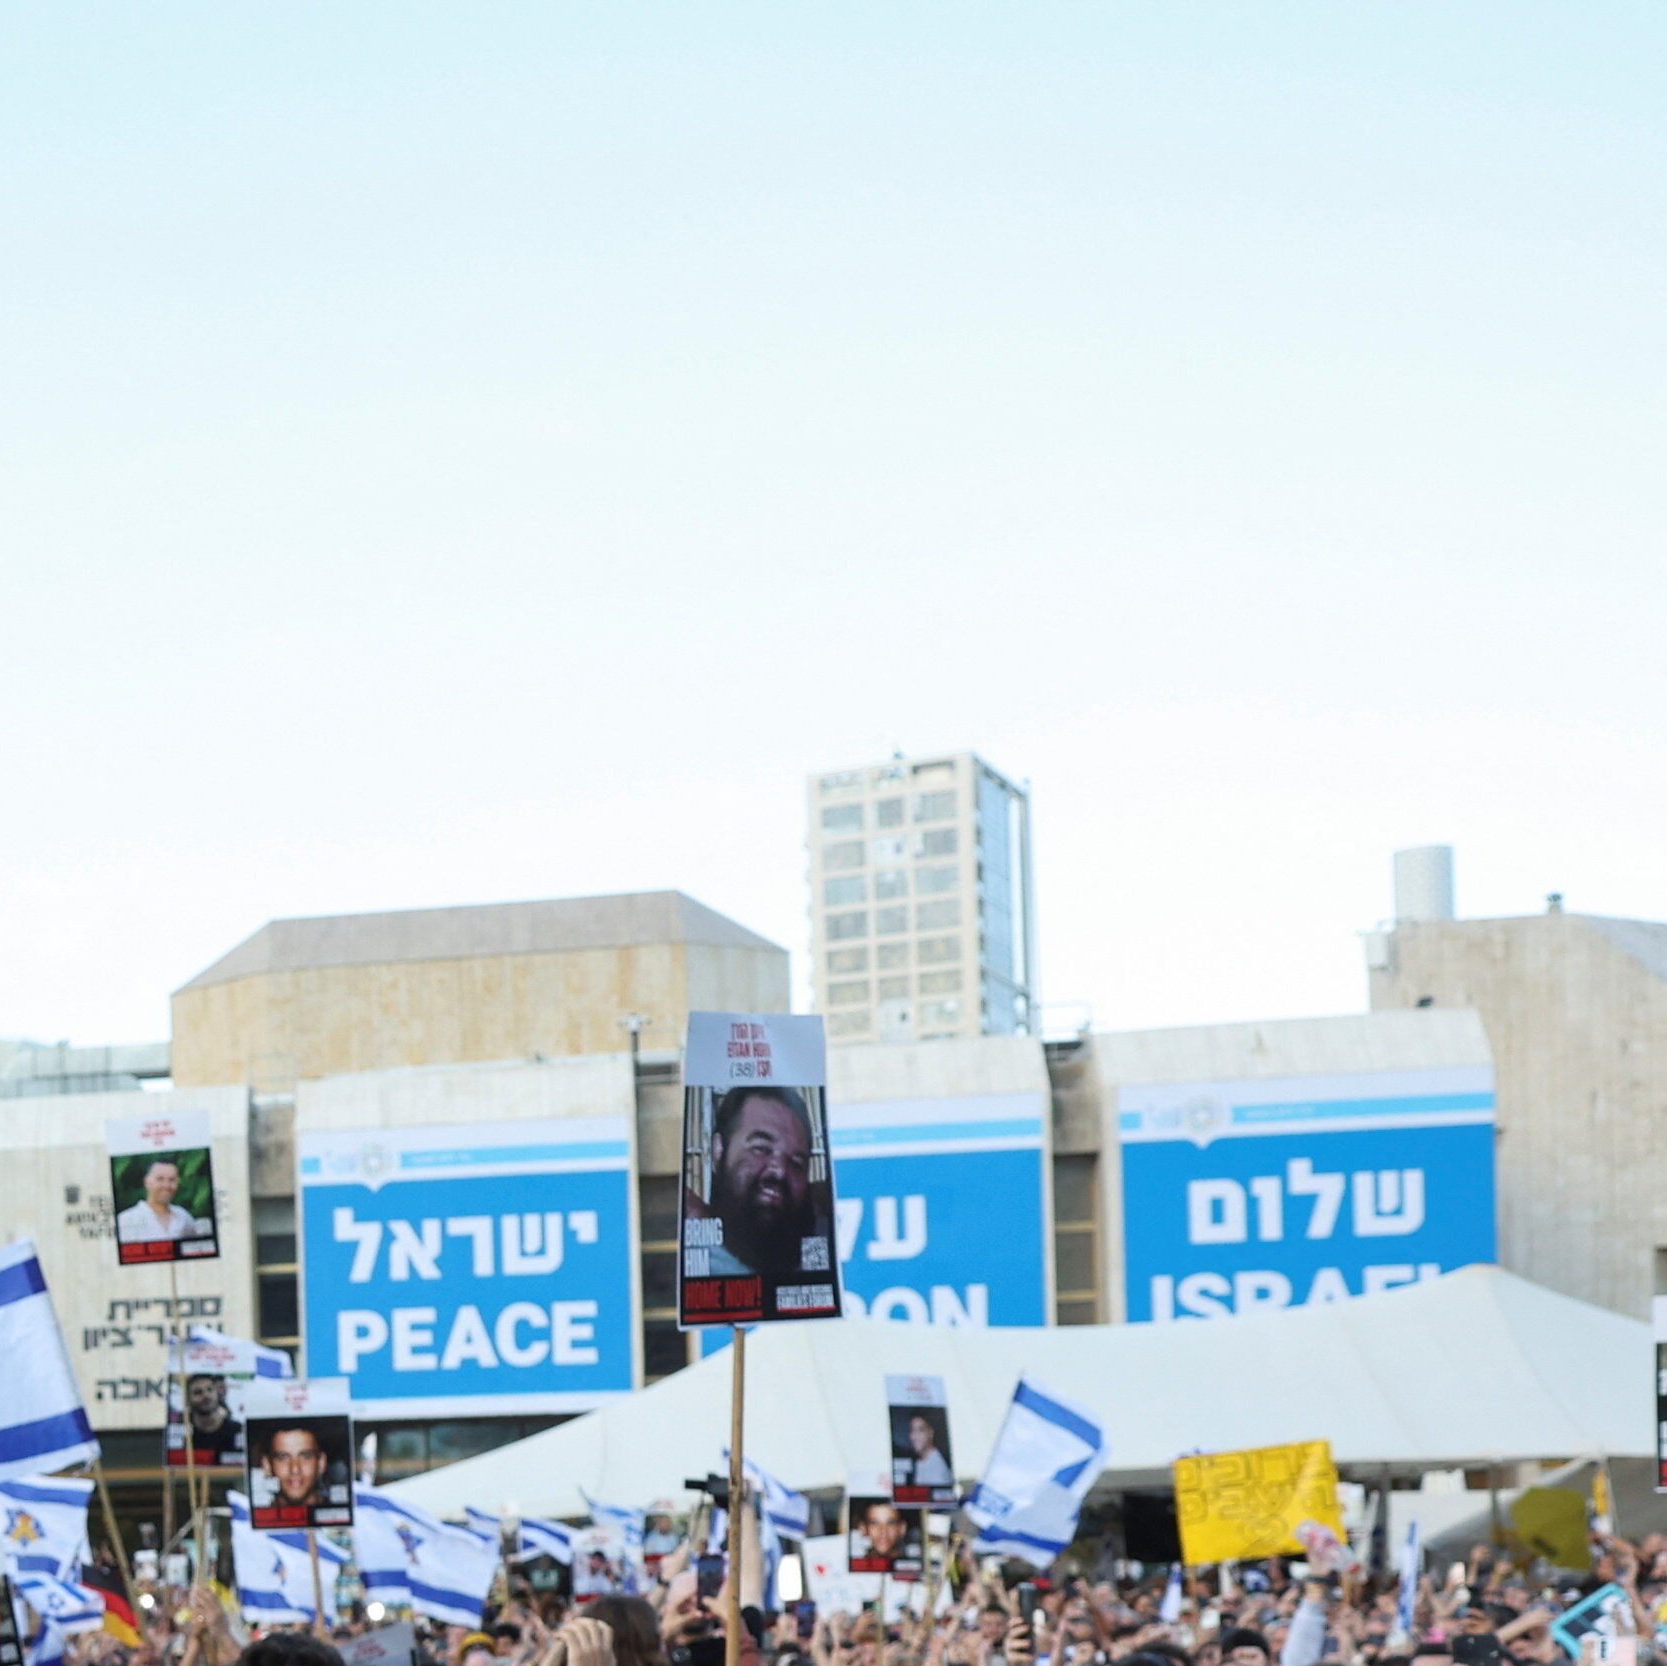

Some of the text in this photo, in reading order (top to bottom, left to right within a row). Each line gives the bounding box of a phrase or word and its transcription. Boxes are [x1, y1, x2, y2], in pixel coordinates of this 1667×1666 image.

[1187, 1157, 1425, 1245] שלום
[332, 1207, 599, 1284] ישראל
[684, 1217, 724, 1247] BRING
[684, 1247, 710, 1277] HIM
[685, 1275, 762, 1309] HOME NOW!
[337, 1301, 599, 1374] PEACE
